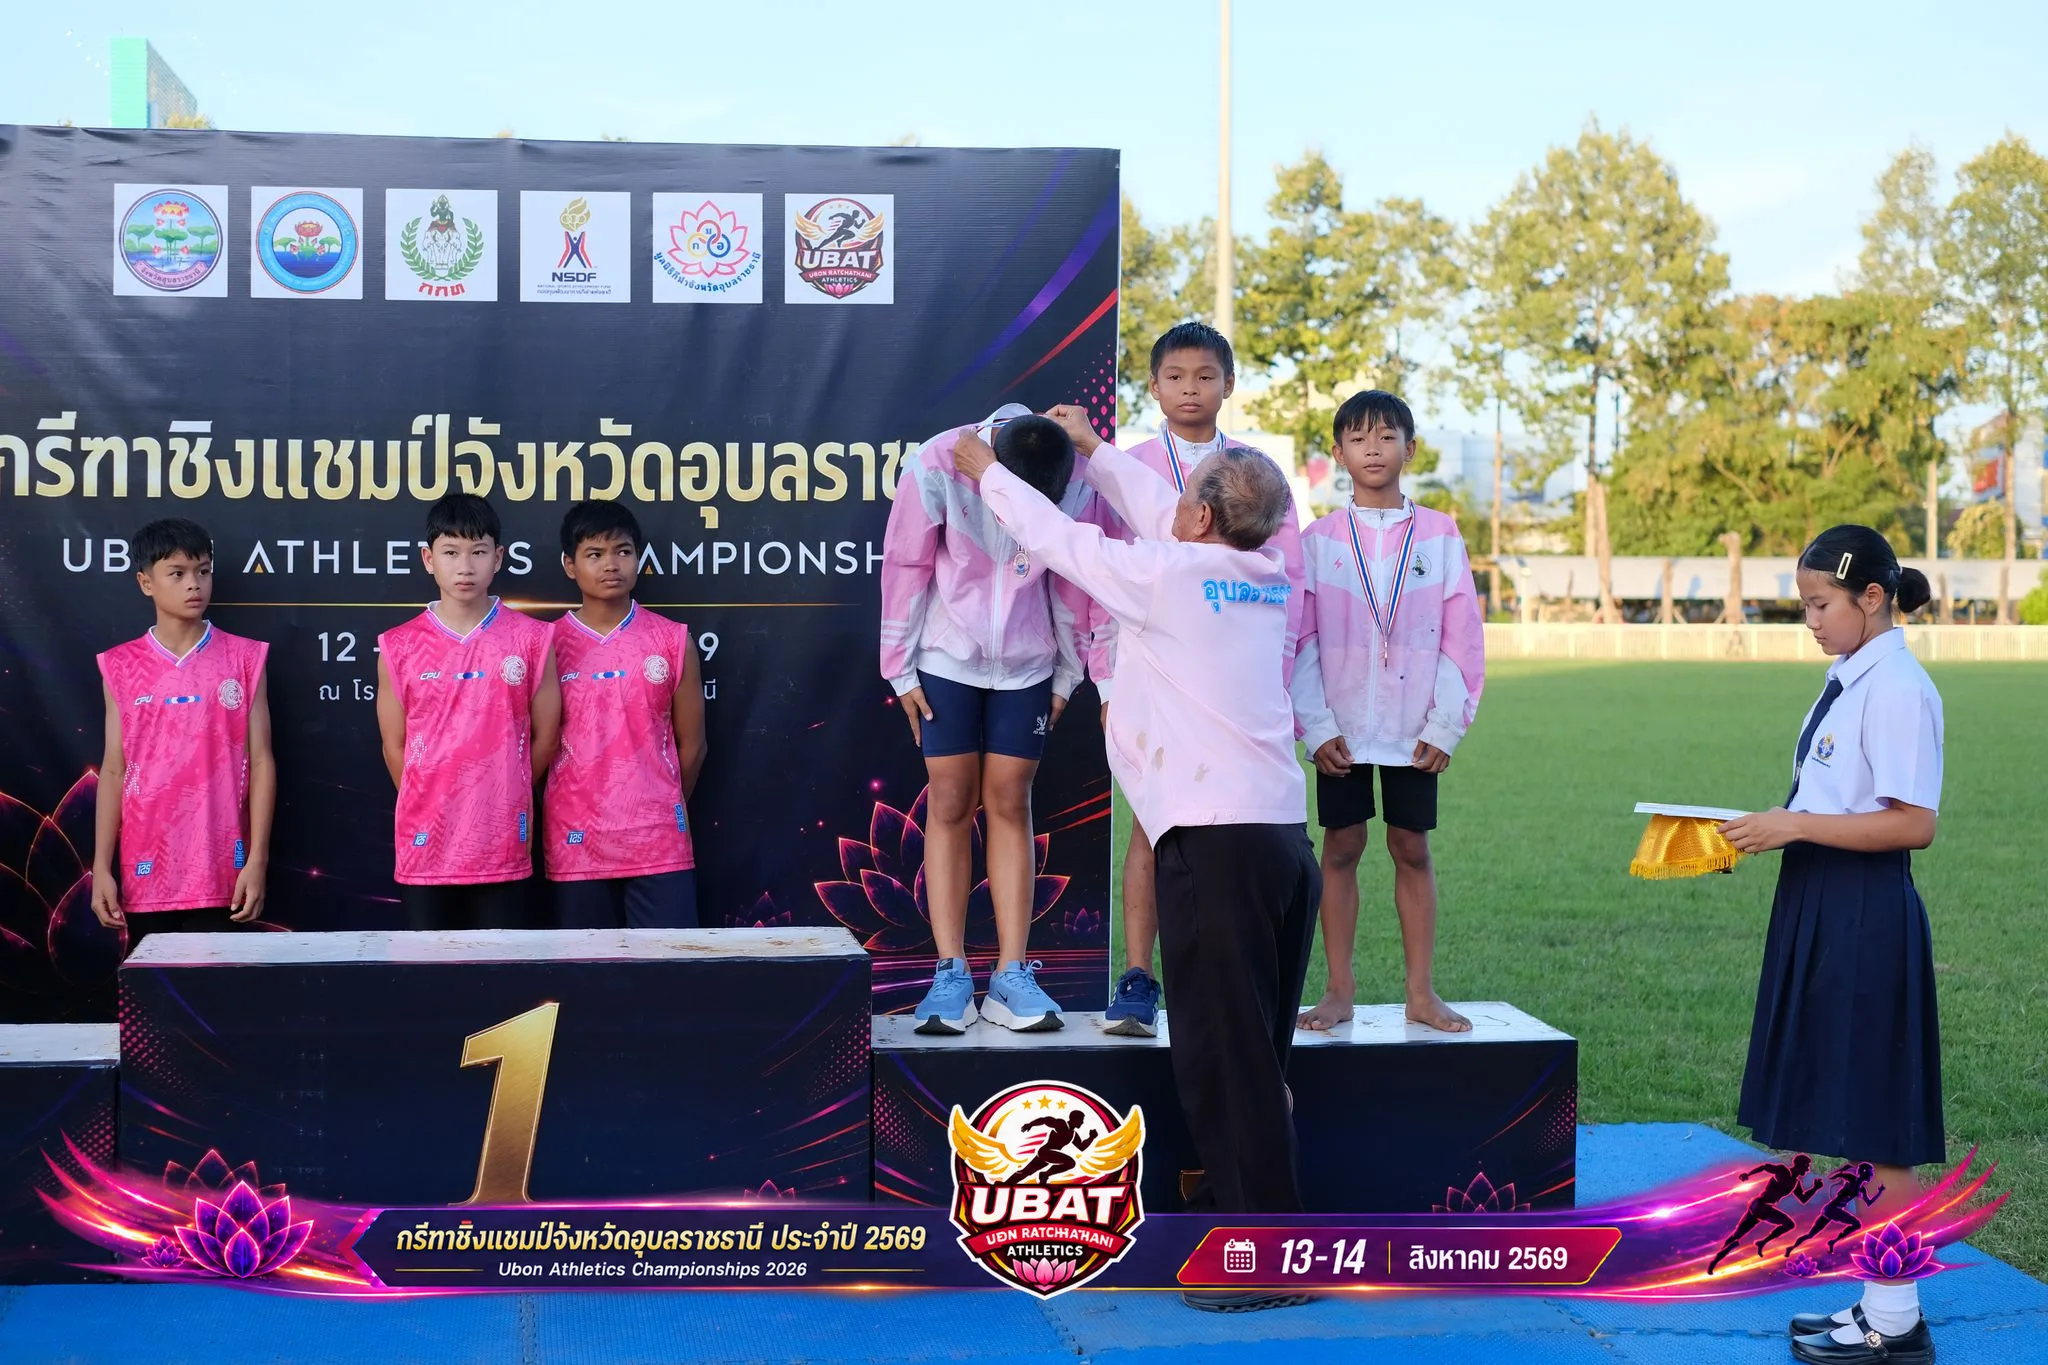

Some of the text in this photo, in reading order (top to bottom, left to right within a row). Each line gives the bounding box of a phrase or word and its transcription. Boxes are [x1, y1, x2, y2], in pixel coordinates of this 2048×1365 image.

[801, 250, 877, 269] UBAT
[551, 272, 597, 283] NSDF
[828, 269, 872, 279] RATCHATHANI
[318, 631, 356, 662] 12
[448, 1002, 560, 1207] 1
